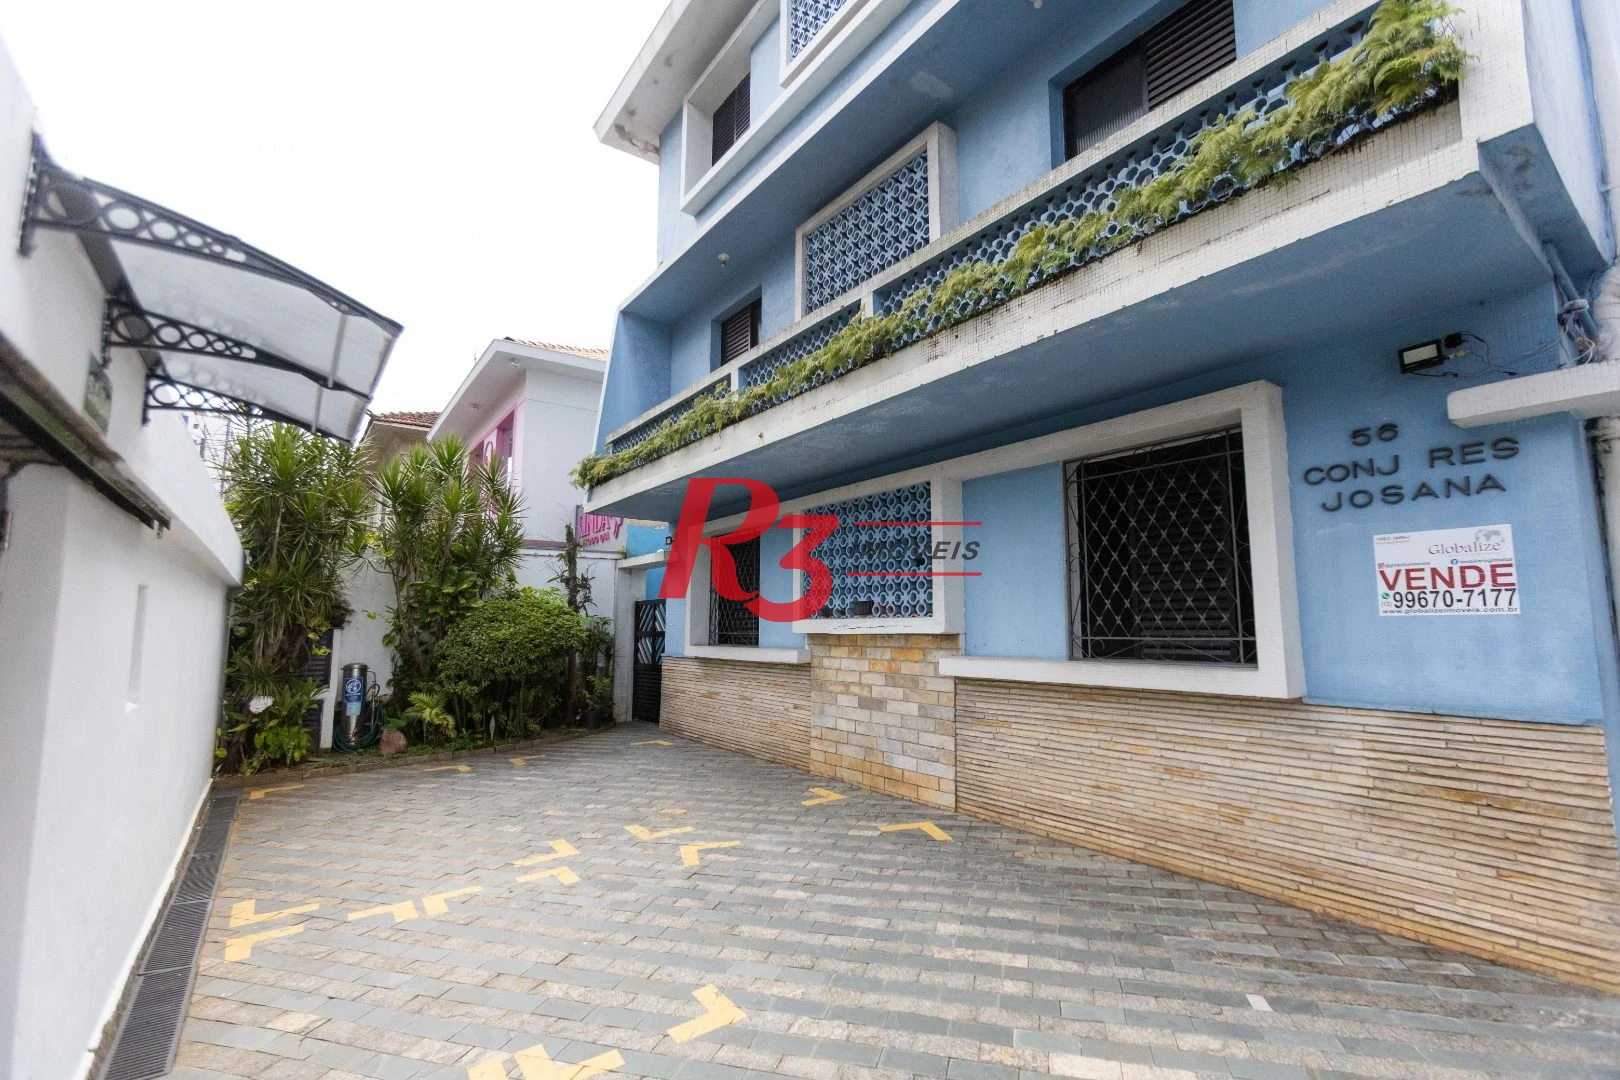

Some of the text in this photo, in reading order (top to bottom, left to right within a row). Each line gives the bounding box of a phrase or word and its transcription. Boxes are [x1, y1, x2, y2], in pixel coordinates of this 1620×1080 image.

[1351, 423, 1399, 446] 56
[1304, 437, 1520, 486] CONJ RES
[1321, 473, 1506, 513] JOSANA
[1428, 541, 1502, 555] Globalize
[1378, 563, 1516, 591] VENDE
[1393, 588, 1517, 609] 99670-7177
